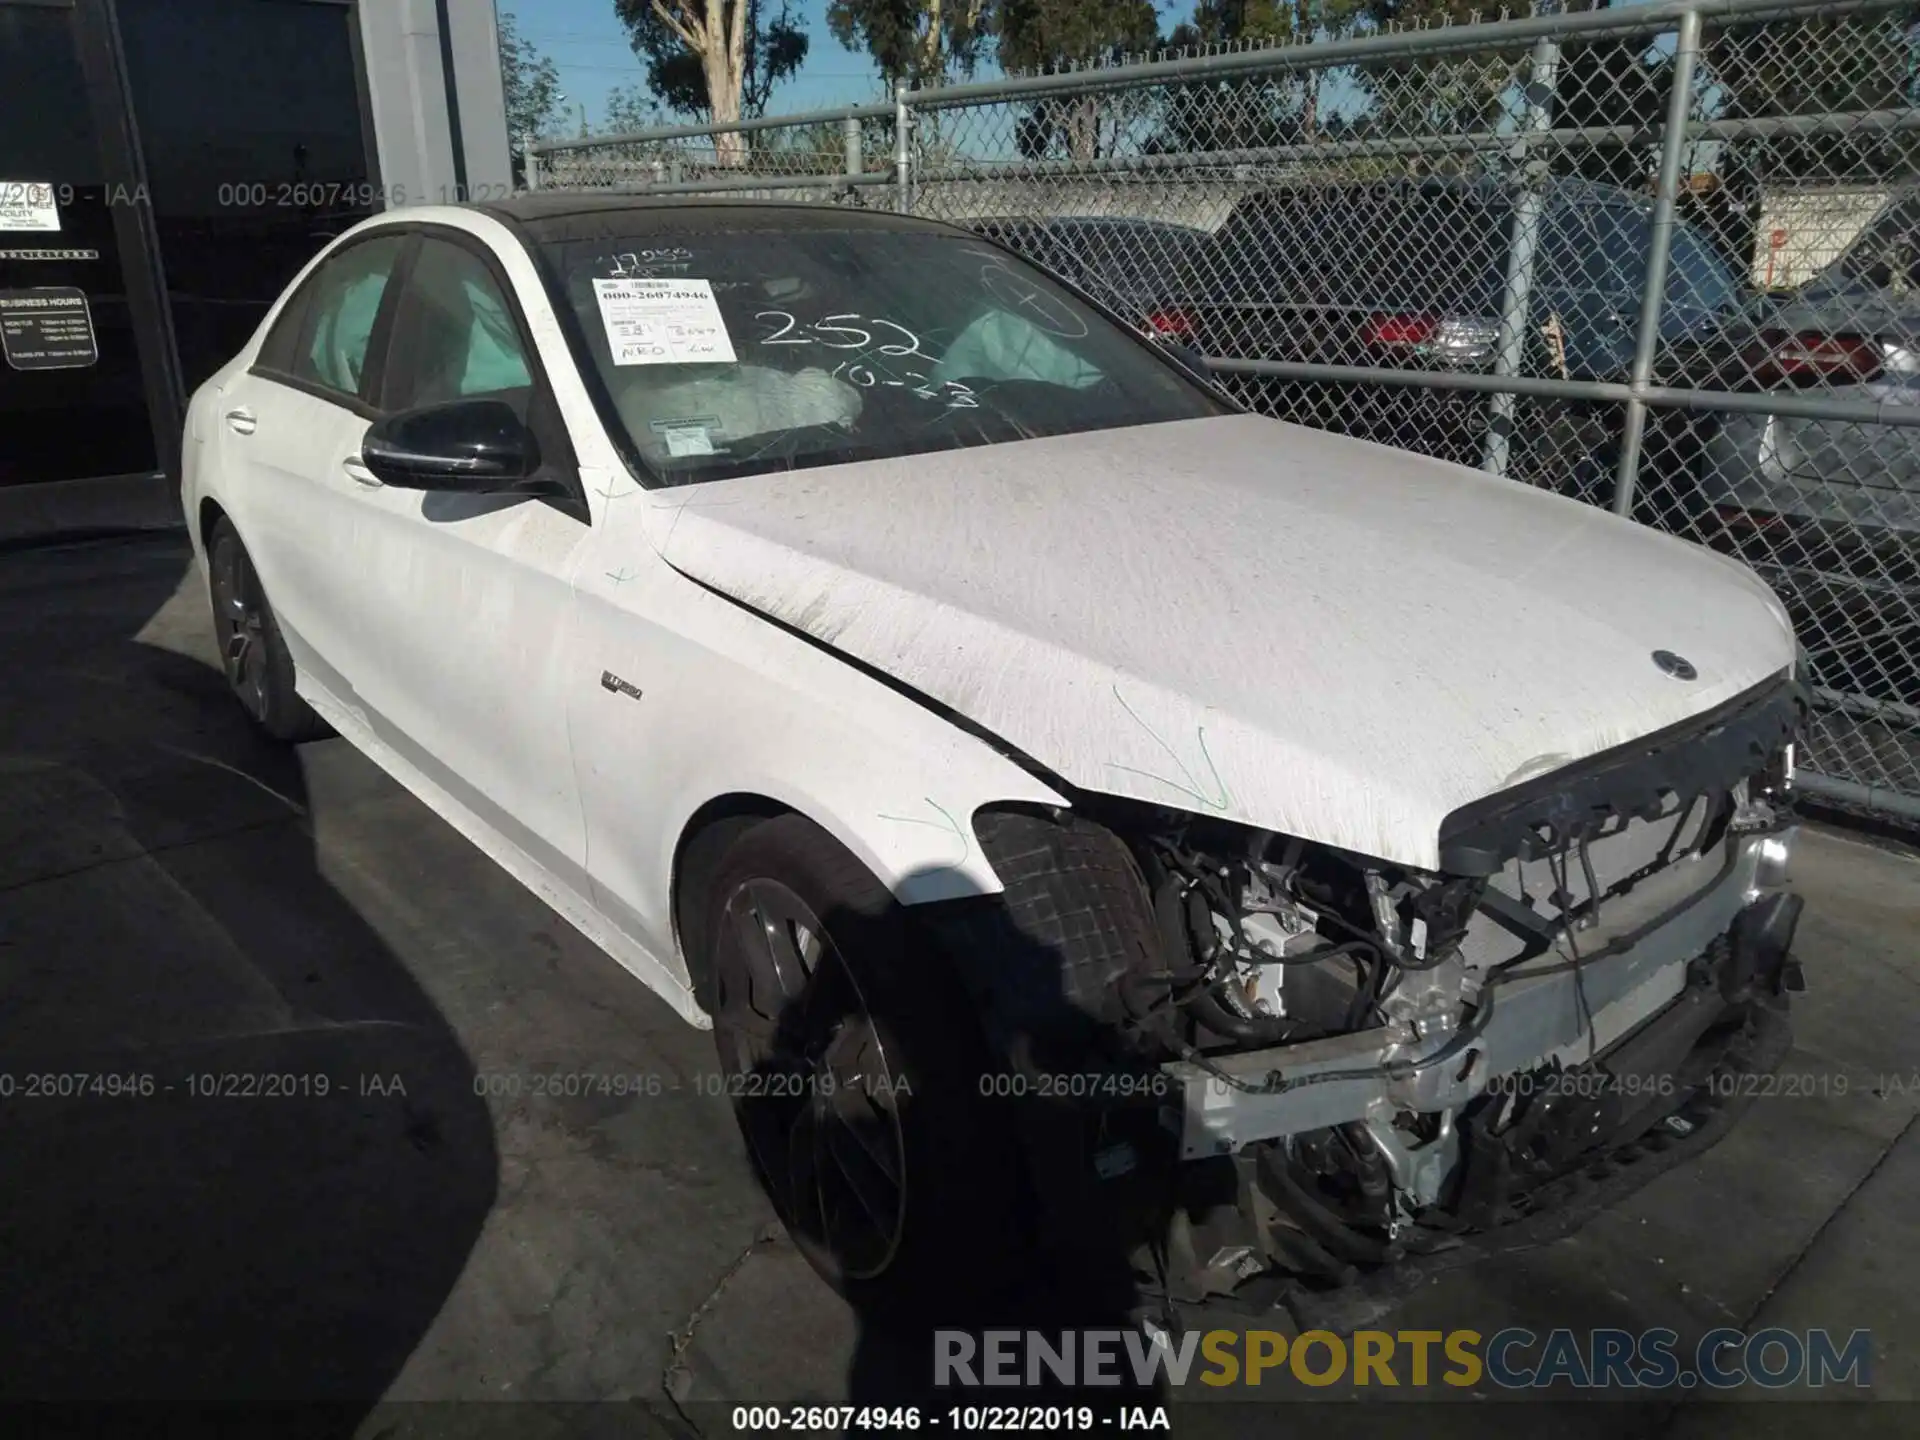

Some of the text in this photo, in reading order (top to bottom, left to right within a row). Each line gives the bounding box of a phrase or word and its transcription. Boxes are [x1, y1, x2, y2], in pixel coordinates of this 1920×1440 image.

[603, 291, 709, 300] 000-26074946
[0, 297, 82, 307] BUSINESS HOURS
